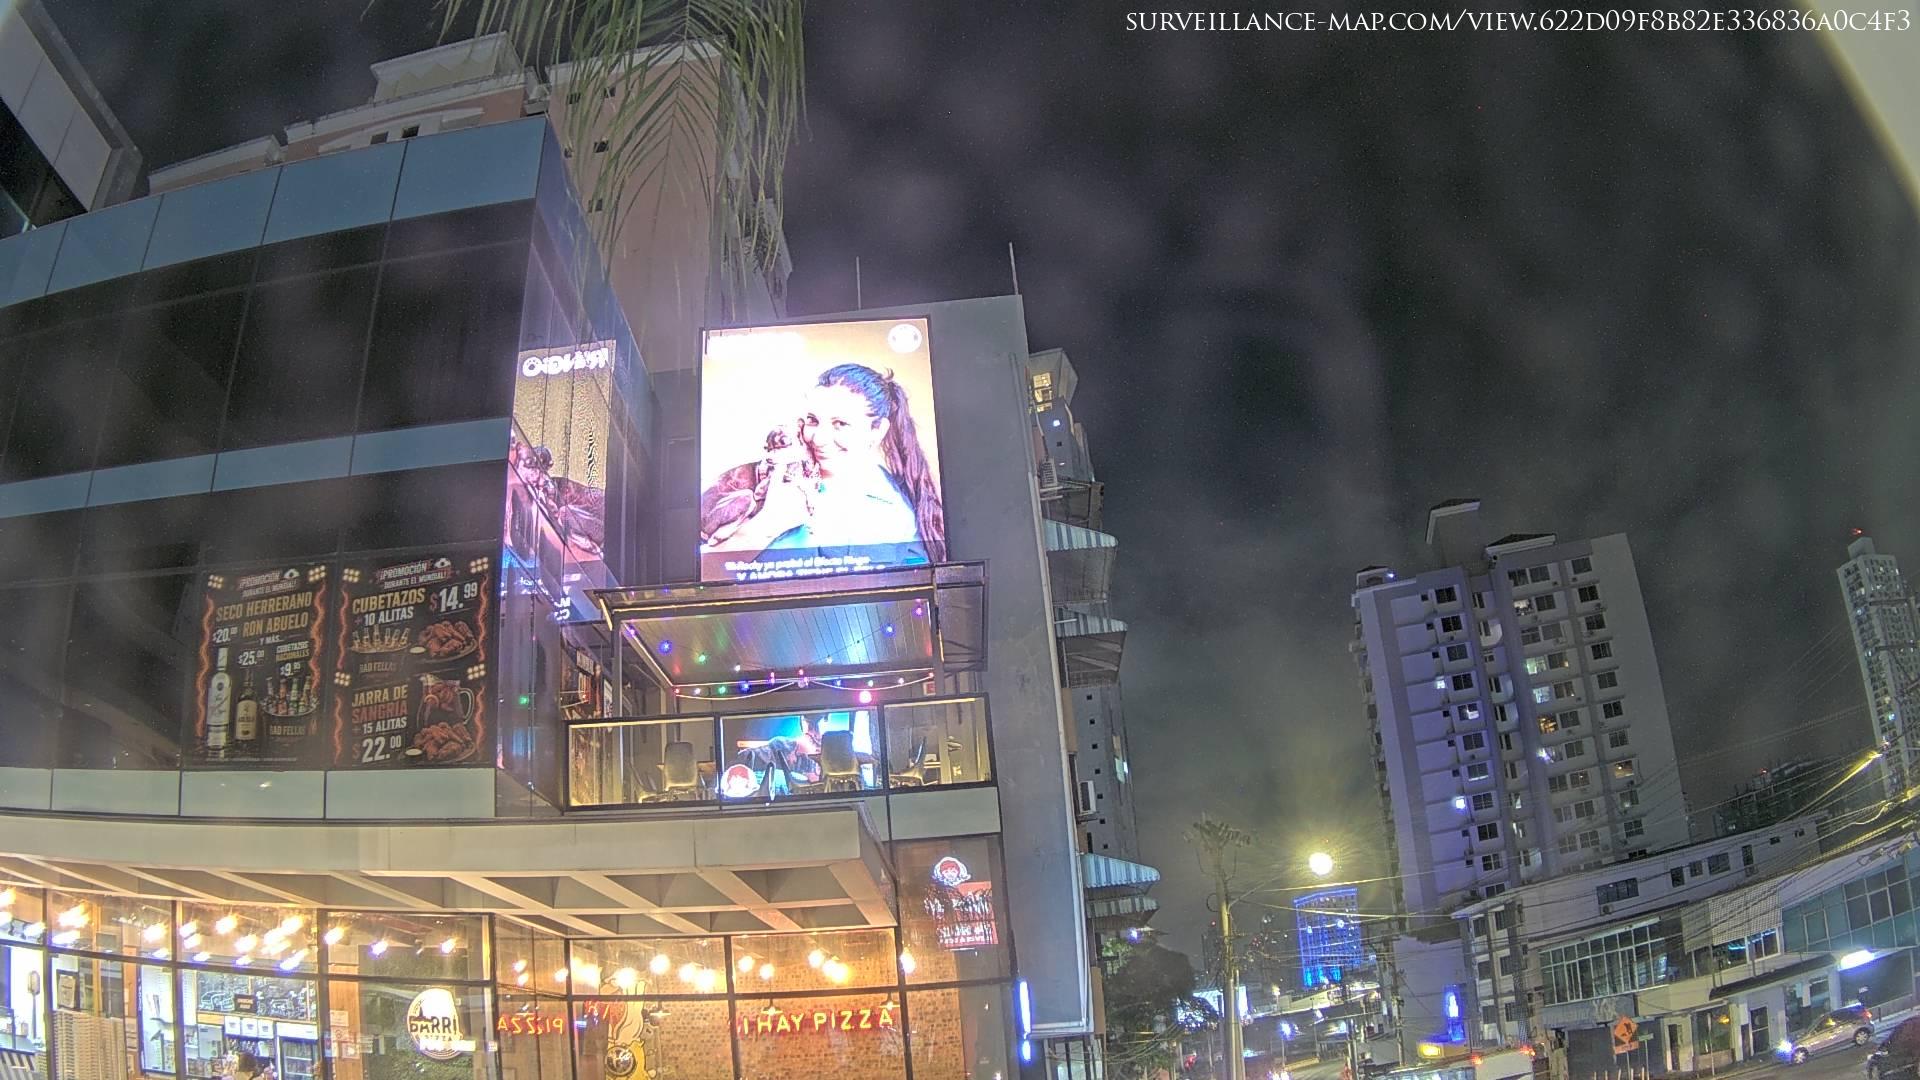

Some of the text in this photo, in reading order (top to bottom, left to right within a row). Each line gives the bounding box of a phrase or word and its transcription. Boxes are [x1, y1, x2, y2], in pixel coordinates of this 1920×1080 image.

[215, 592, 312, 622] SECO HERRERANO
[352, 588, 426, 614] CUBETAZOS
[243, 612, 309, 638] RON ABUELO
[364, 613, 375, 627] 10
[378, 606, 414, 624] ALITAS
[352, 685, 409, 707] JARRA DE
[363, 721, 373, 734] 15
[375, 716, 408, 732] ALITAS
[757, 1012, 804, 1033] HAY
[813, 1008, 893, 1031] PIZZA
